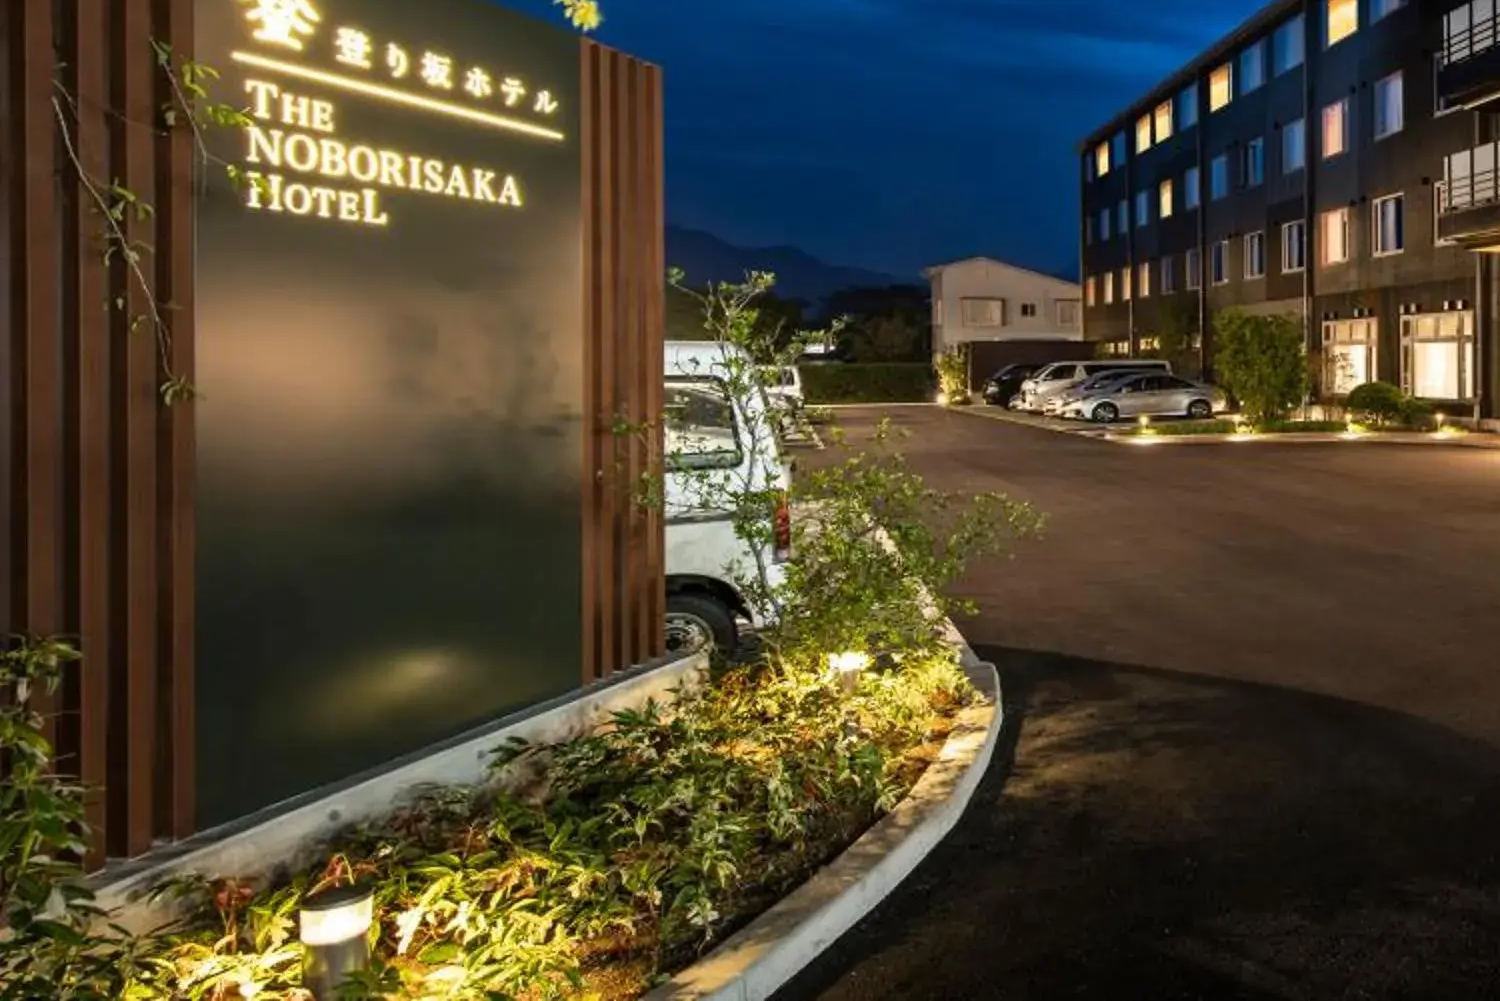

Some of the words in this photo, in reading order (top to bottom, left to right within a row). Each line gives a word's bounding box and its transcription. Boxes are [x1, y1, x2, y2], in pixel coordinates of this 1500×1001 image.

[246, 80, 335, 132] THE
[246, 126, 522, 207] NOBORISAKA
[247, 172, 388, 225] HOTEL
